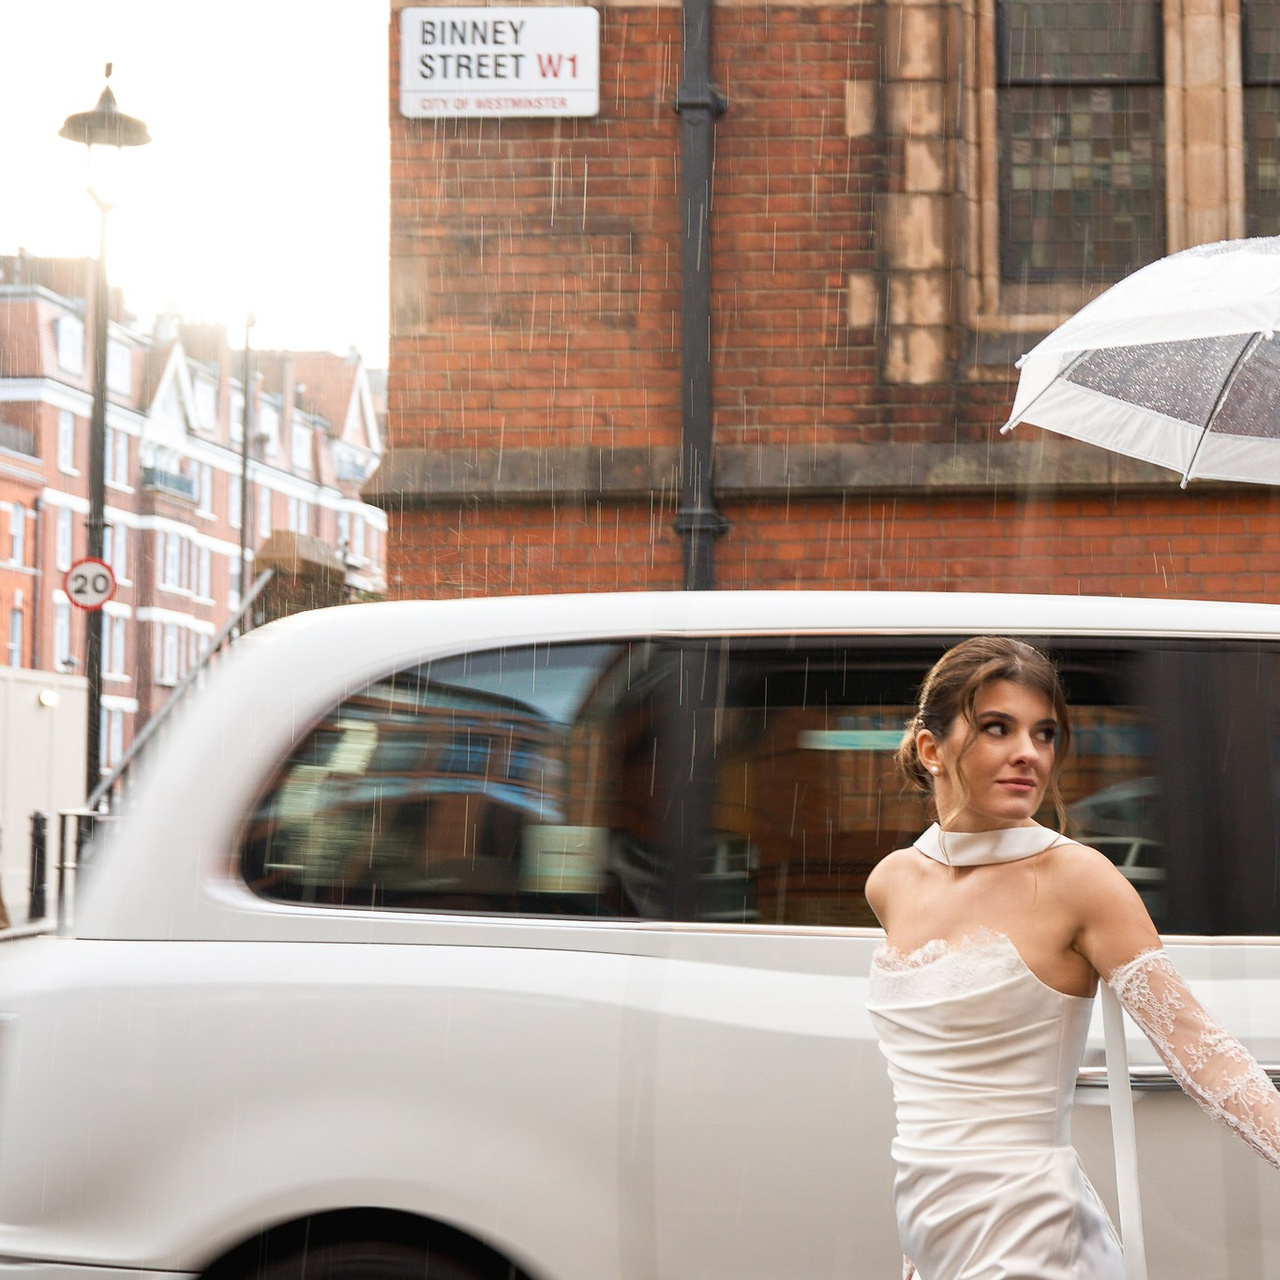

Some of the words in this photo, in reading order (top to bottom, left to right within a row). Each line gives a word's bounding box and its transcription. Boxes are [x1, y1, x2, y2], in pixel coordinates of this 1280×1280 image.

[421, 20, 525, 45] BINNEY
[420, 53, 525, 79] STREET
[536, 53, 578, 78] W1
[420, 97, 448, 110] CITY
[454, 97, 468, 110] OF
[476, 97, 568, 110] WESTMINSTER
[73, 574, 109, 594] 20
